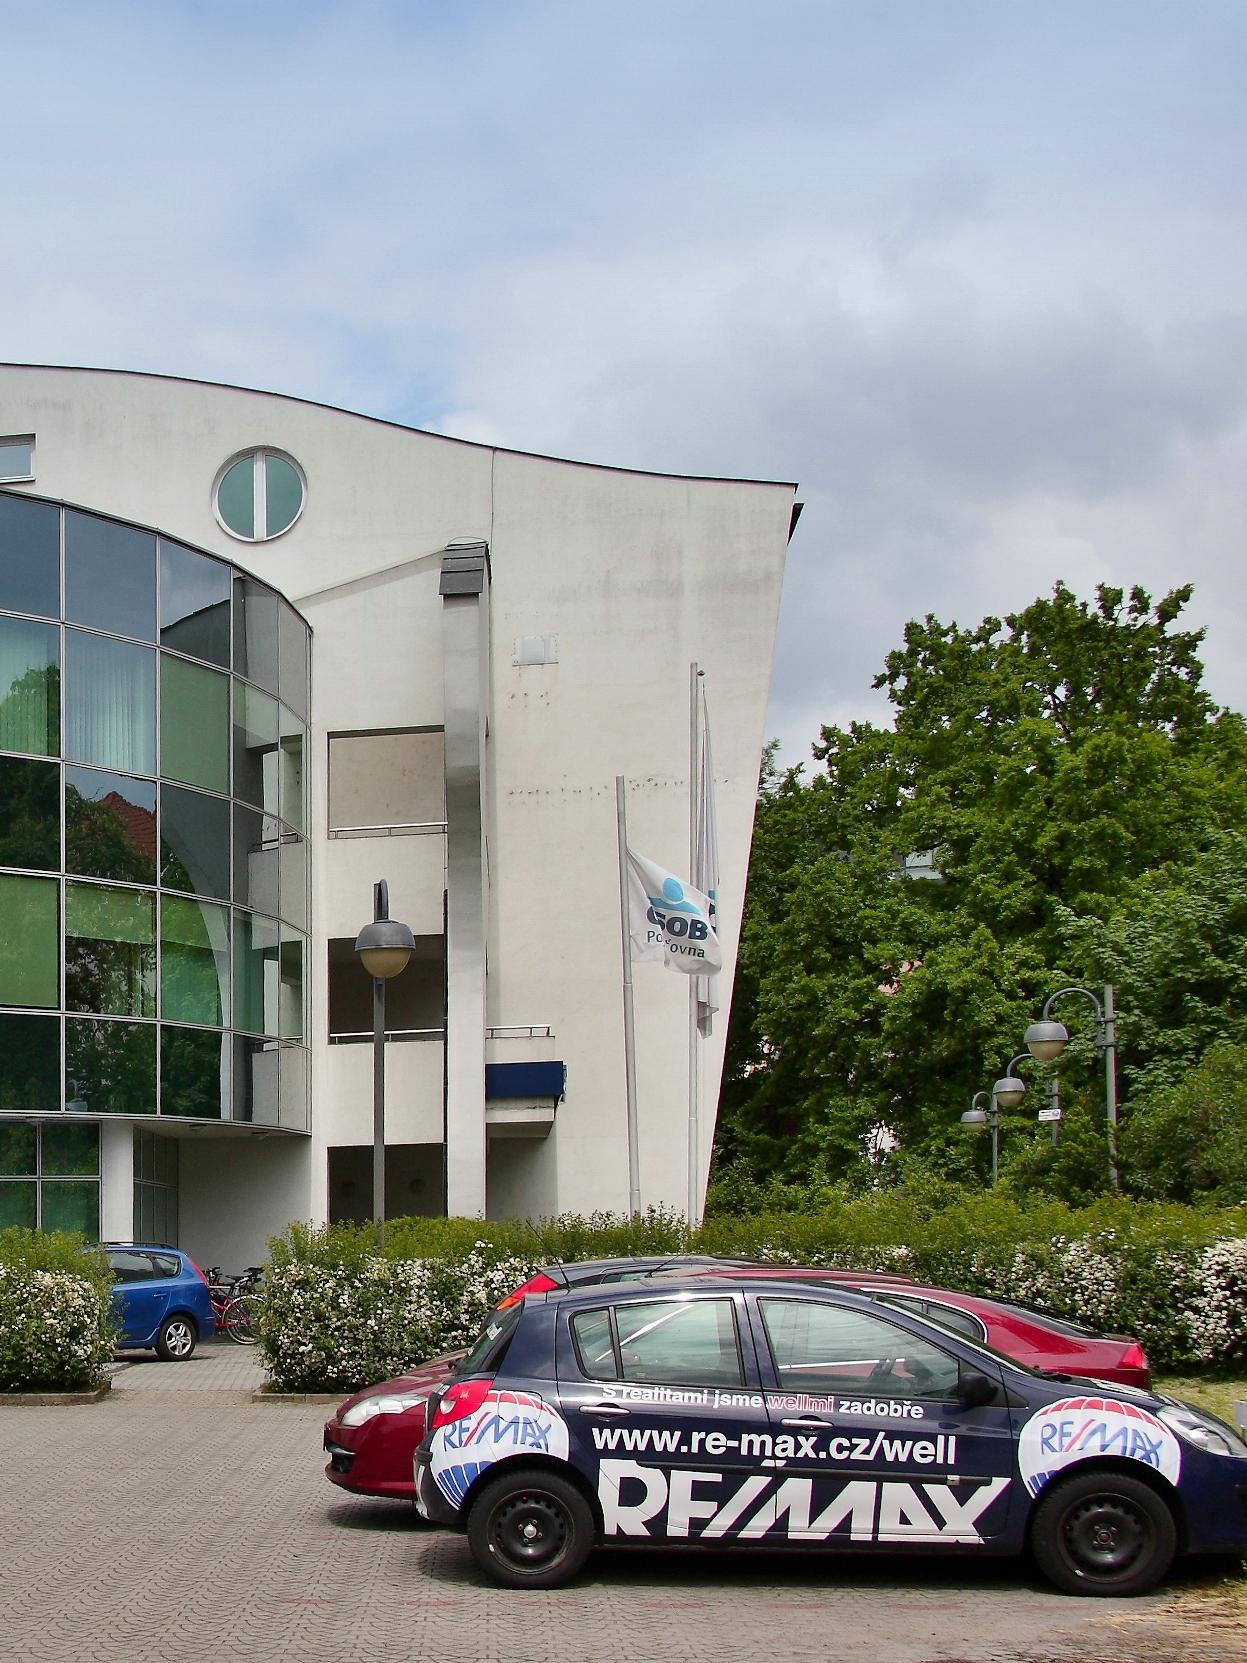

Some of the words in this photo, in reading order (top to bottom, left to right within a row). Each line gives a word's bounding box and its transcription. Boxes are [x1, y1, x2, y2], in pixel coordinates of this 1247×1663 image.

[602, 1384, 616, 1398] S
[622, 1386, 707, 1404] realitami
[712, 1390, 762, 1408] jsme
[766, 1394, 835, 1413] wellmi
[838, 1399, 924, 1419] zadobře
[443, 1411, 552, 1453] RE/MAX
[591, 1427, 956, 1465] www.re-max.cz/well
[1040, 1418, 1163, 1469] RE/MAX
[597, 1458, 1012, 1545] RE/MAX
